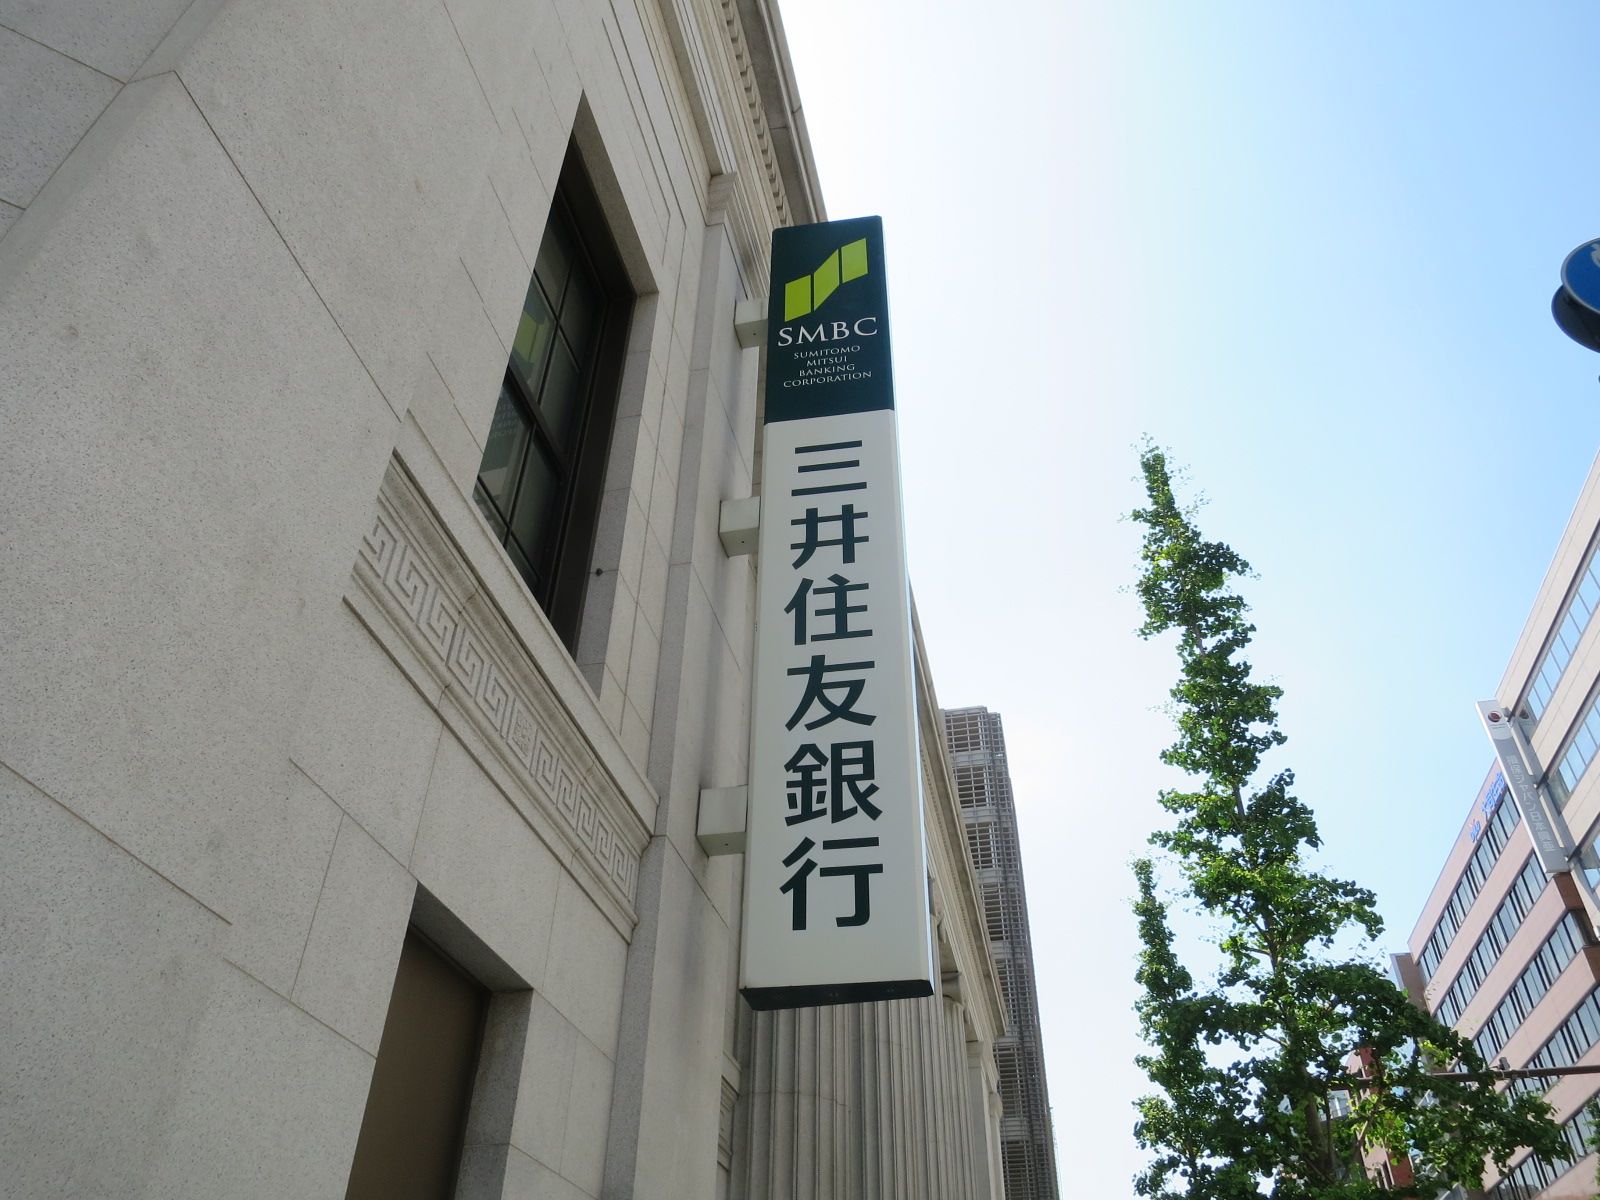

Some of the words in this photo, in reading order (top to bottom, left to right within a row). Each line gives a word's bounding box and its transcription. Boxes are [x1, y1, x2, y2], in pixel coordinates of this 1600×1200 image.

[777, 317, 878, 347] SMBC
[793, 345, 860, 359] SUMITOMO
[806, 355, 848, 367] MITSUI
[799, 363, 855, 377] BANKING
[783, 371, 872, 388] CORPORATION
[779, 440, 883, 931] 三井住友銀行
